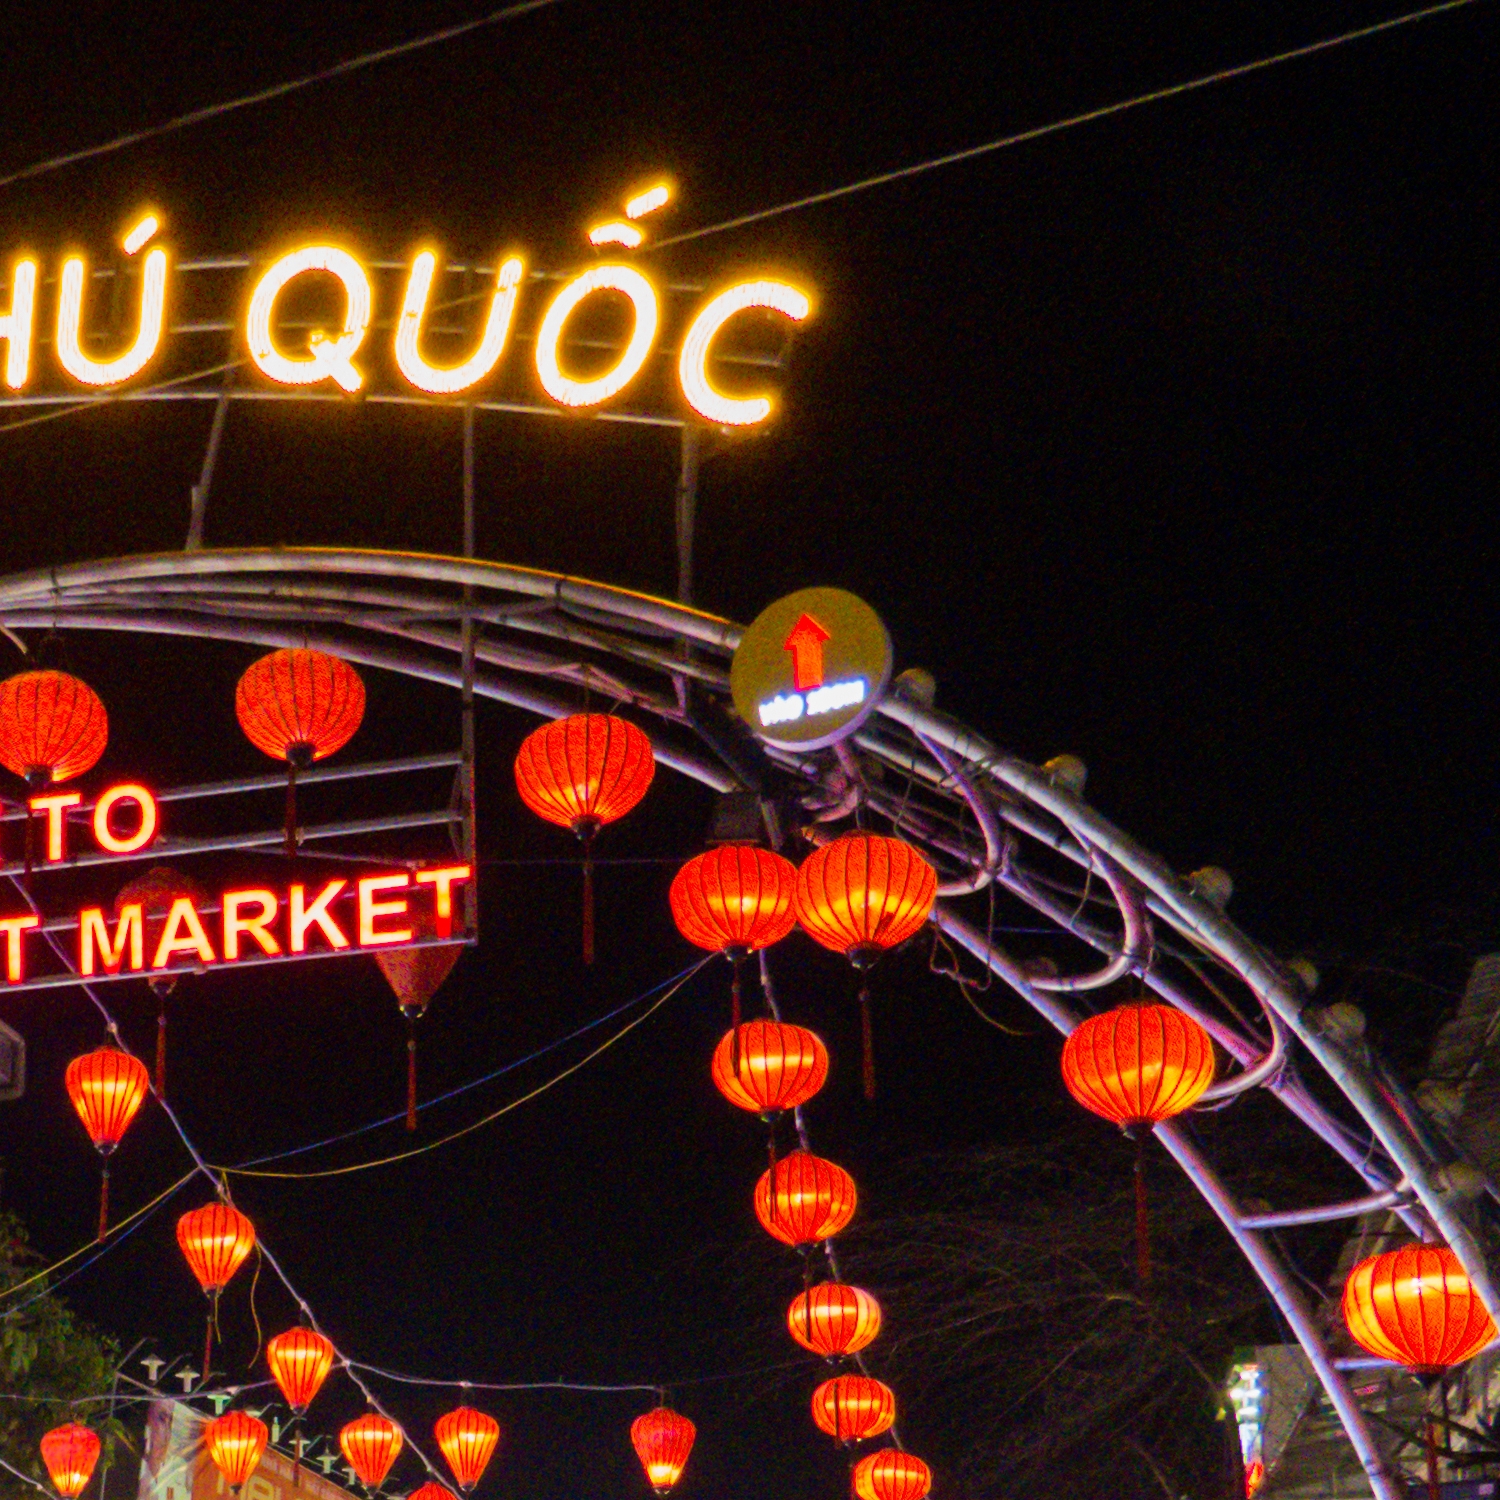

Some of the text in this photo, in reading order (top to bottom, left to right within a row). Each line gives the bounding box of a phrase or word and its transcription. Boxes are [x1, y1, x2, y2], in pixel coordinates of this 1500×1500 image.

[245, 184, 811, 428] QUỐC
[30, 782, 160, 864] TO
[78, 865, 473, 976] MARKET
